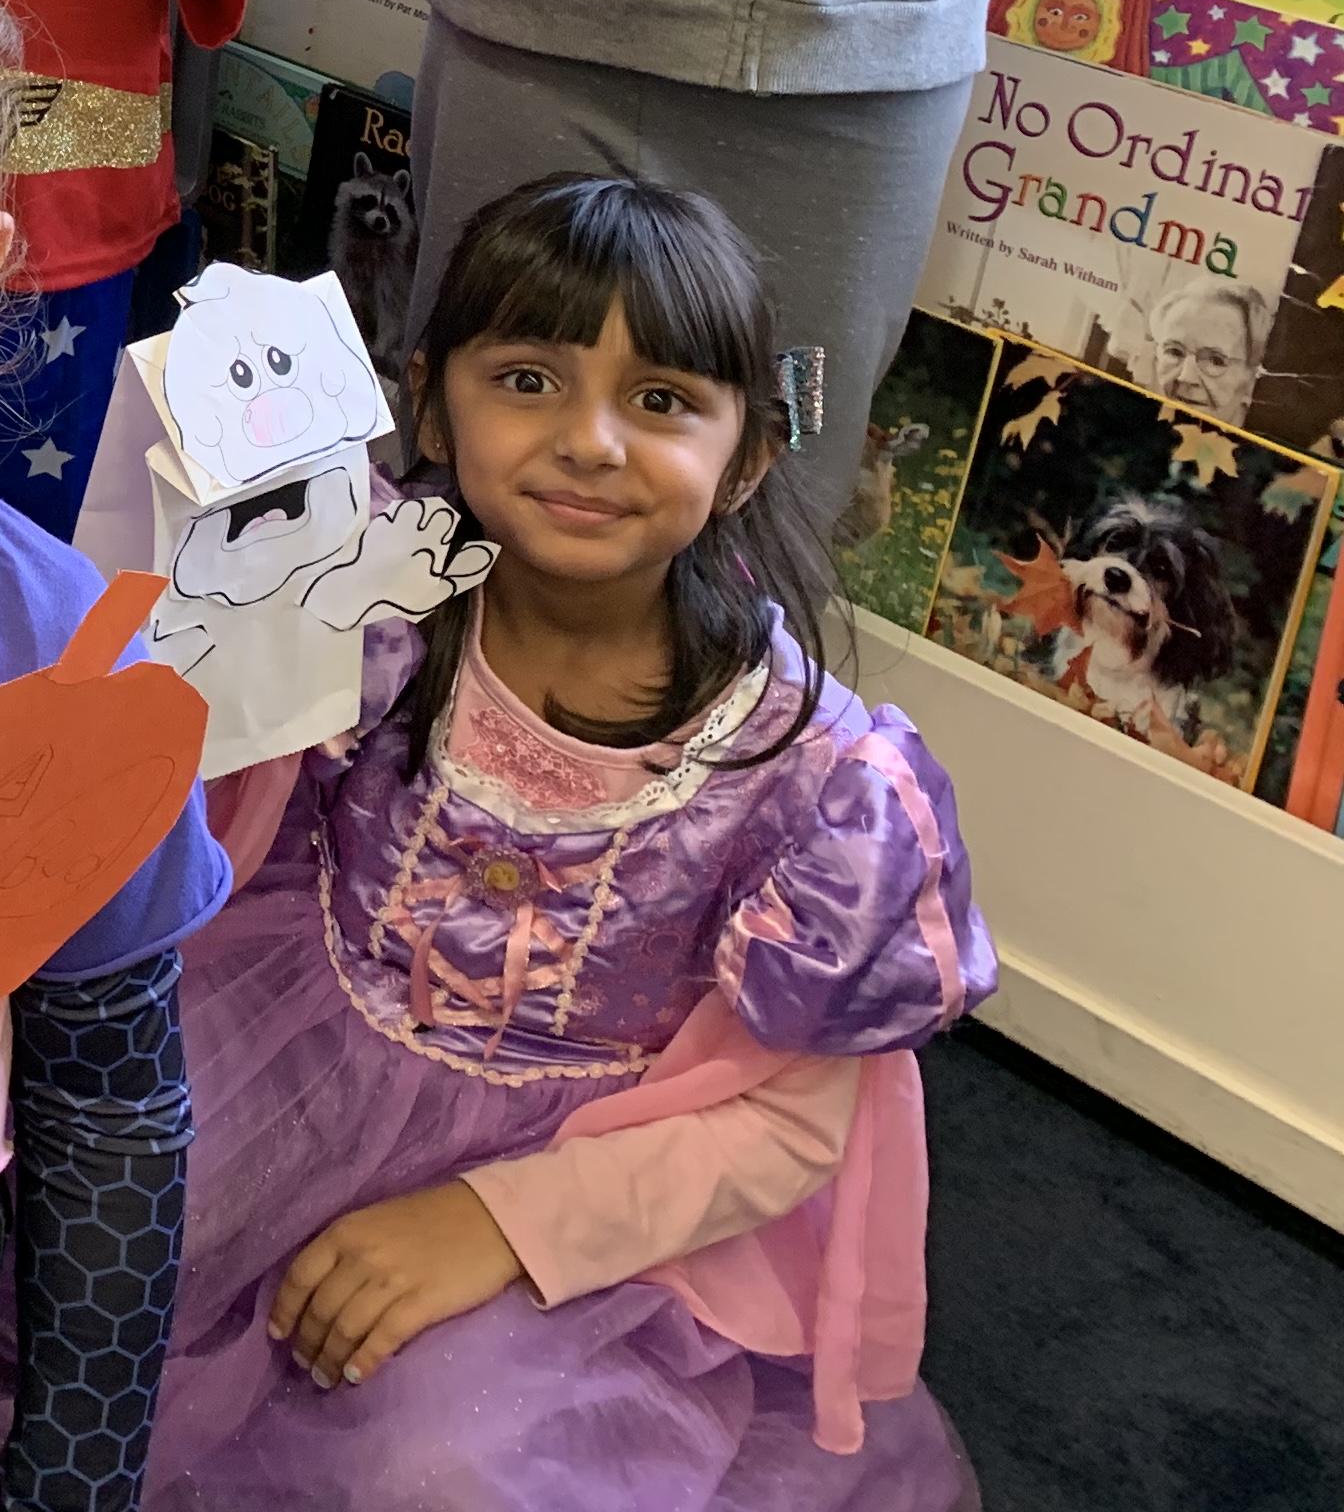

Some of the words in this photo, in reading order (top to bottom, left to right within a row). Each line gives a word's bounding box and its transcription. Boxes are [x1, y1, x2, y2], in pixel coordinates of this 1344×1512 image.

[397, 2, 412, 15] Pat
[977, 71, 1051, 138] No
[963, 141, 1238, 278] Grandma
[947, 221, 994, 249] Written
[998, 238, 1014, 257] by
[1018, 247, 1058, 270] Sarah
[1063, 262, 1119, 292] Witham
